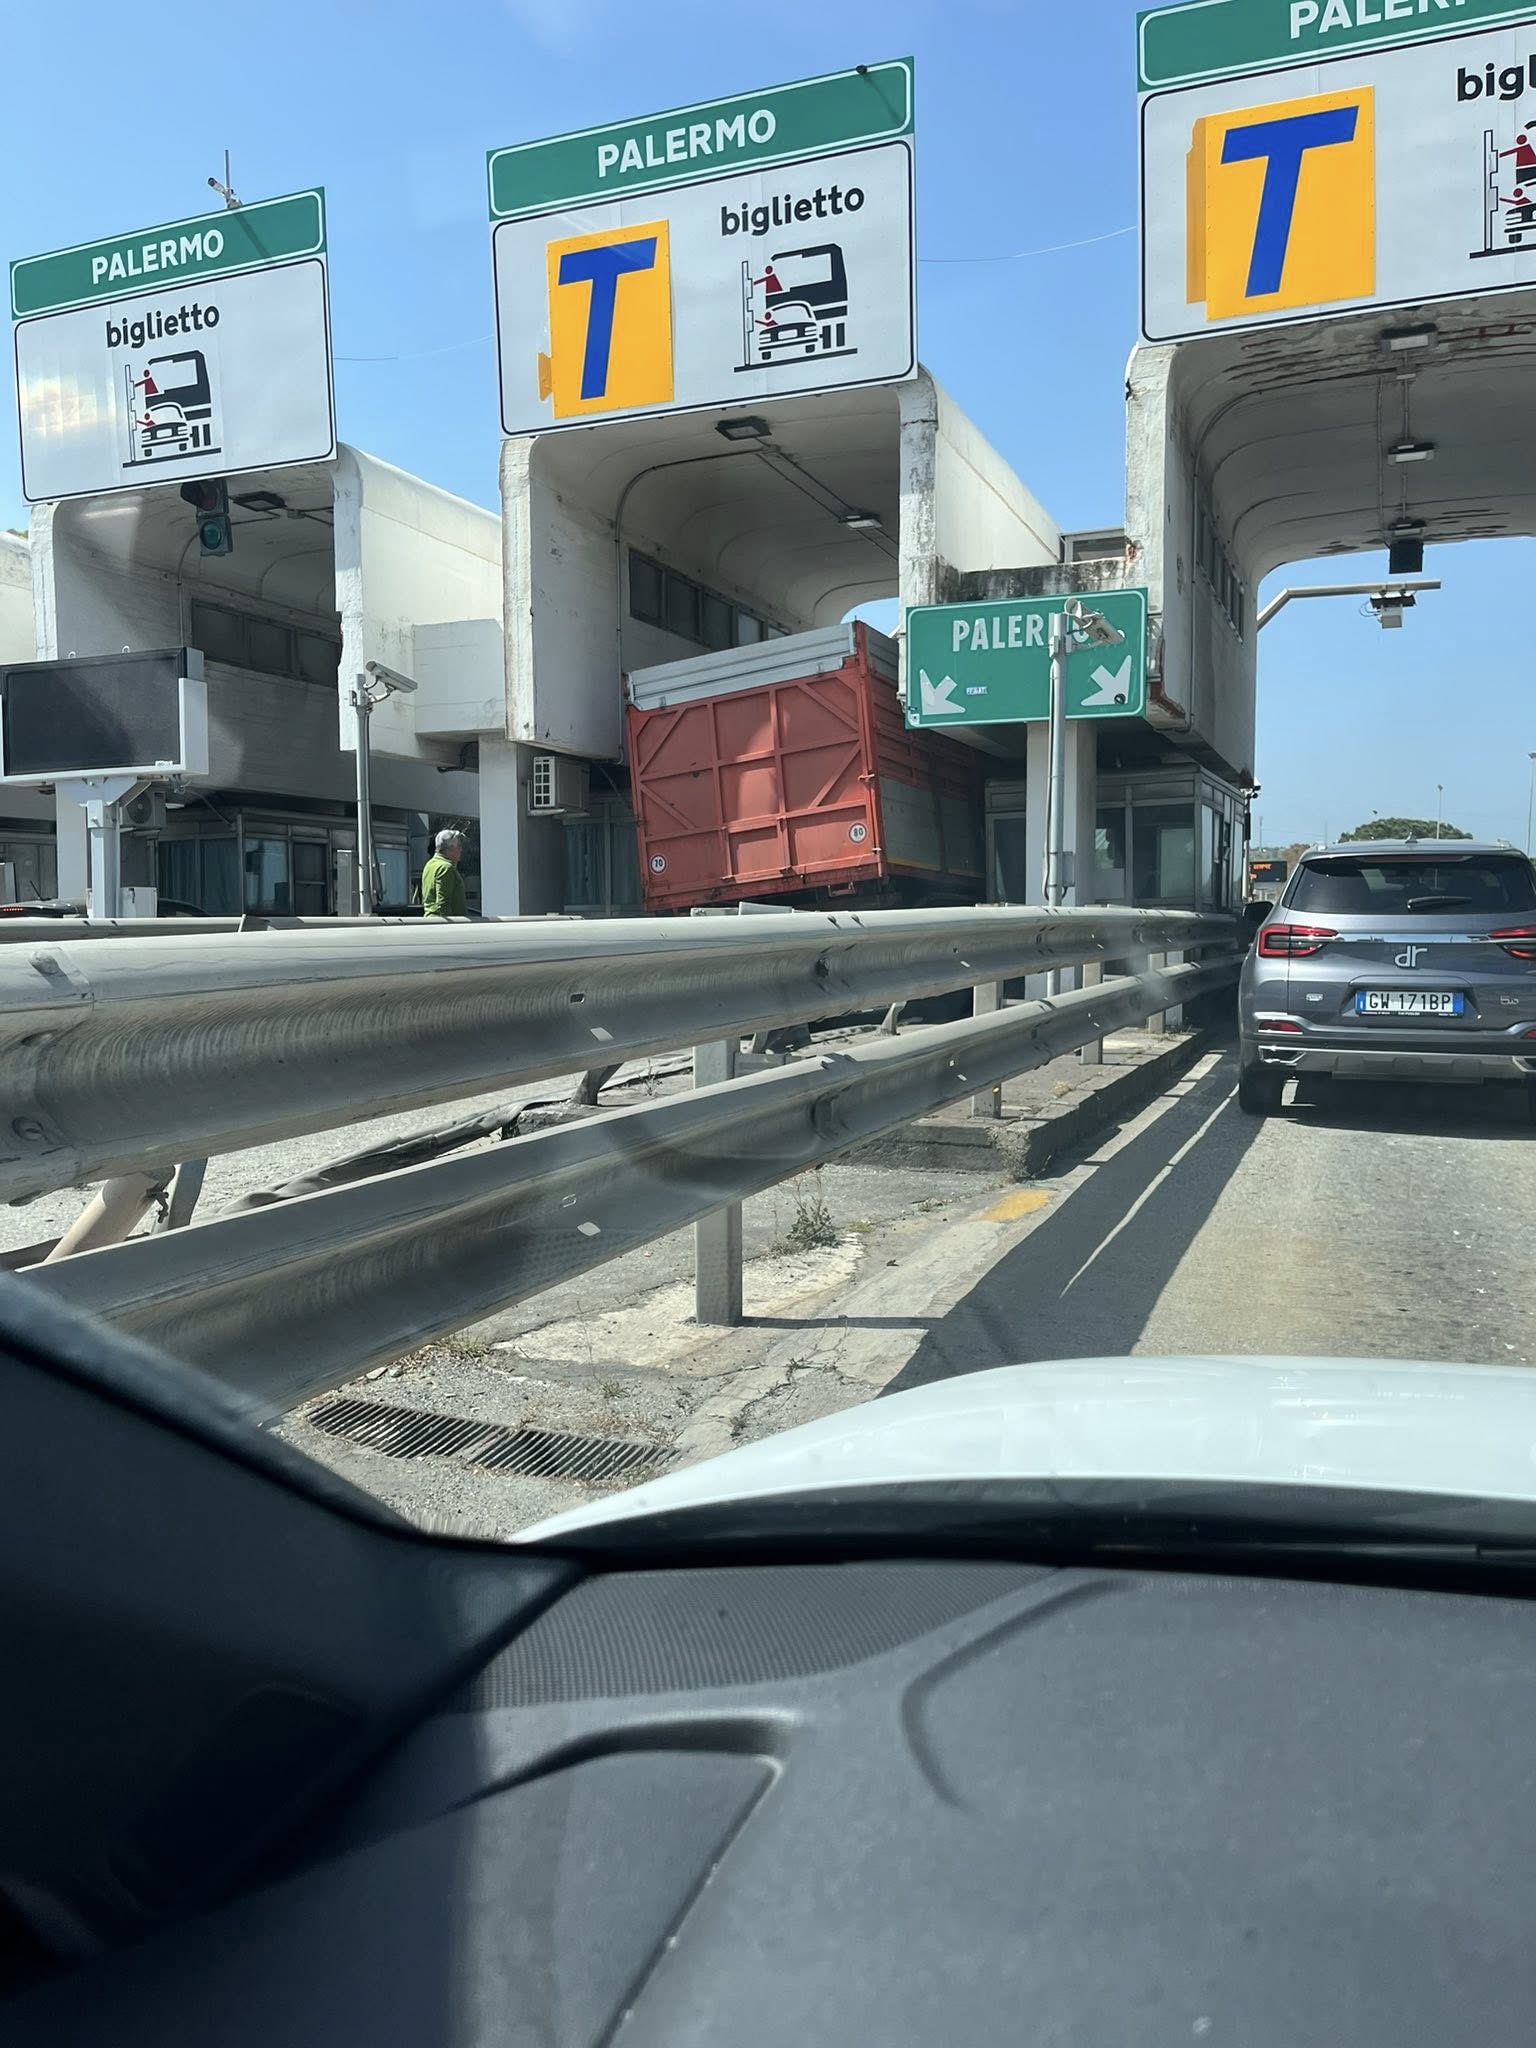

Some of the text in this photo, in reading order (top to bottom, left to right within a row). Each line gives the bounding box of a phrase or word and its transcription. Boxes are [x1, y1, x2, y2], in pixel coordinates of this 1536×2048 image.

[1289, 0, 1466, 39] PALE
[597, 109, 776, 178] PALERMO
[721, 185, 865, 236] biglietto
[1220, 105, 1360, 298] T
[92, 229, 224, 285] PALERMO
[106, 303, 220, 349] biglietto
[558, 236, 658, 400] T
[952, 613, 1091, 652] PALER
[1395, 945, 1428, 967] dr
[1369, 993, 1451, 1010] GW 171BP
